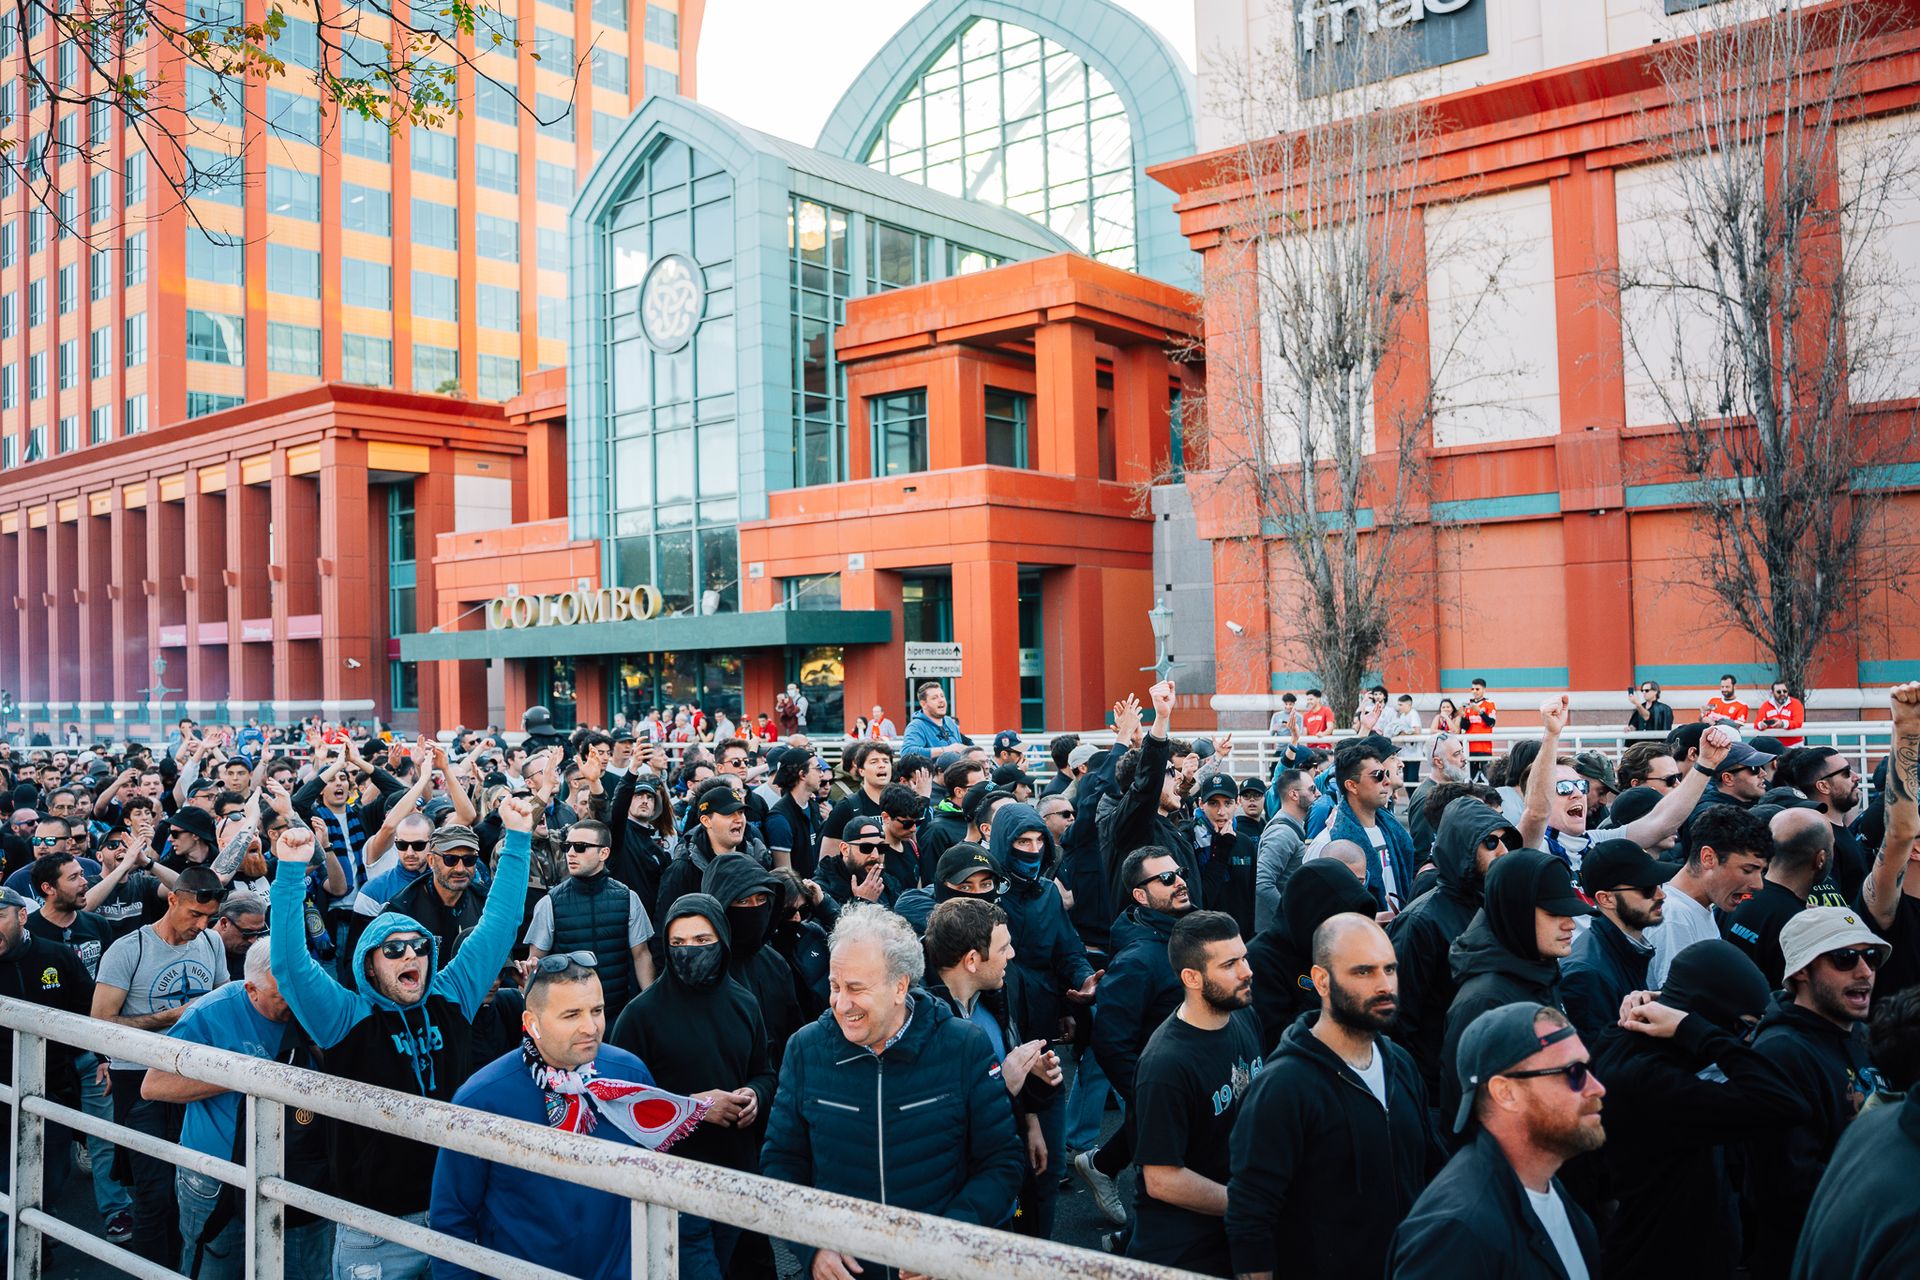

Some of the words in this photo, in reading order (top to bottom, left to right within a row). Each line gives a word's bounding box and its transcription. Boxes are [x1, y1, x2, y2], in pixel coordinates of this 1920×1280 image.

[491, 584, 662, 630] COLOMBO
[907, 646, 952, 656] hipermercado
[157, 969, 179, 992] CURVA
[191, 966, 210, 984] NORD
